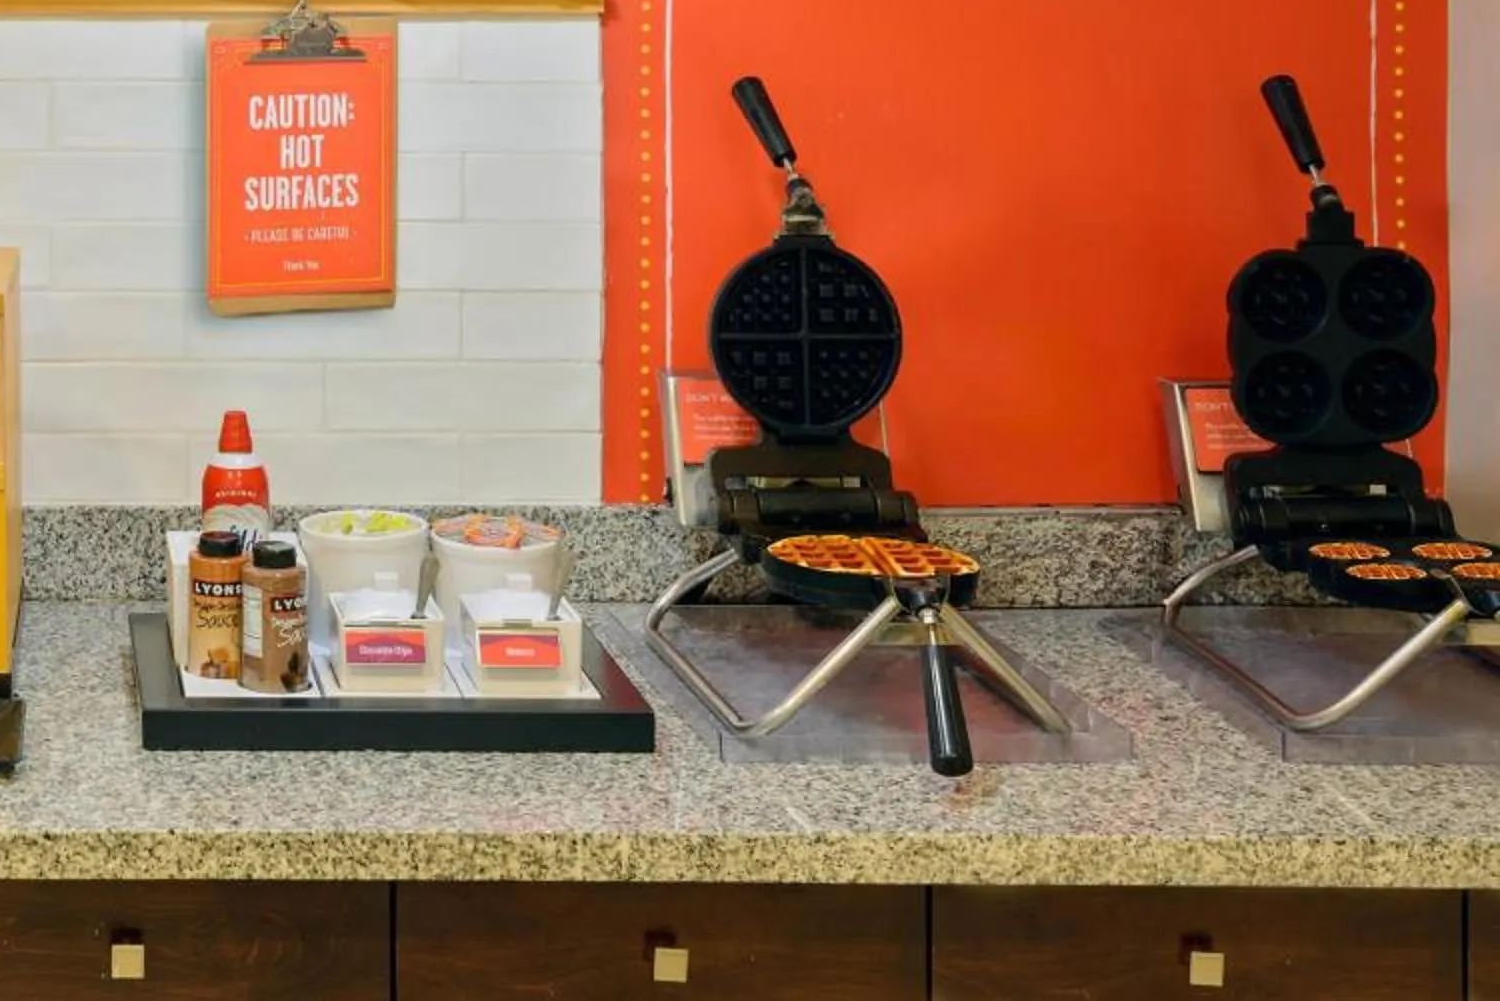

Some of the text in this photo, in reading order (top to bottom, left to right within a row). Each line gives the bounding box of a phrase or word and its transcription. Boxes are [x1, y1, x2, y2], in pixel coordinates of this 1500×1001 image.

[248, 93, 355, 130] CAUTION:
[280, 134, 324, 170] HOT
[244, 173, 360, 211] SURFACES
[195, 582, 243, 596] LYONS
